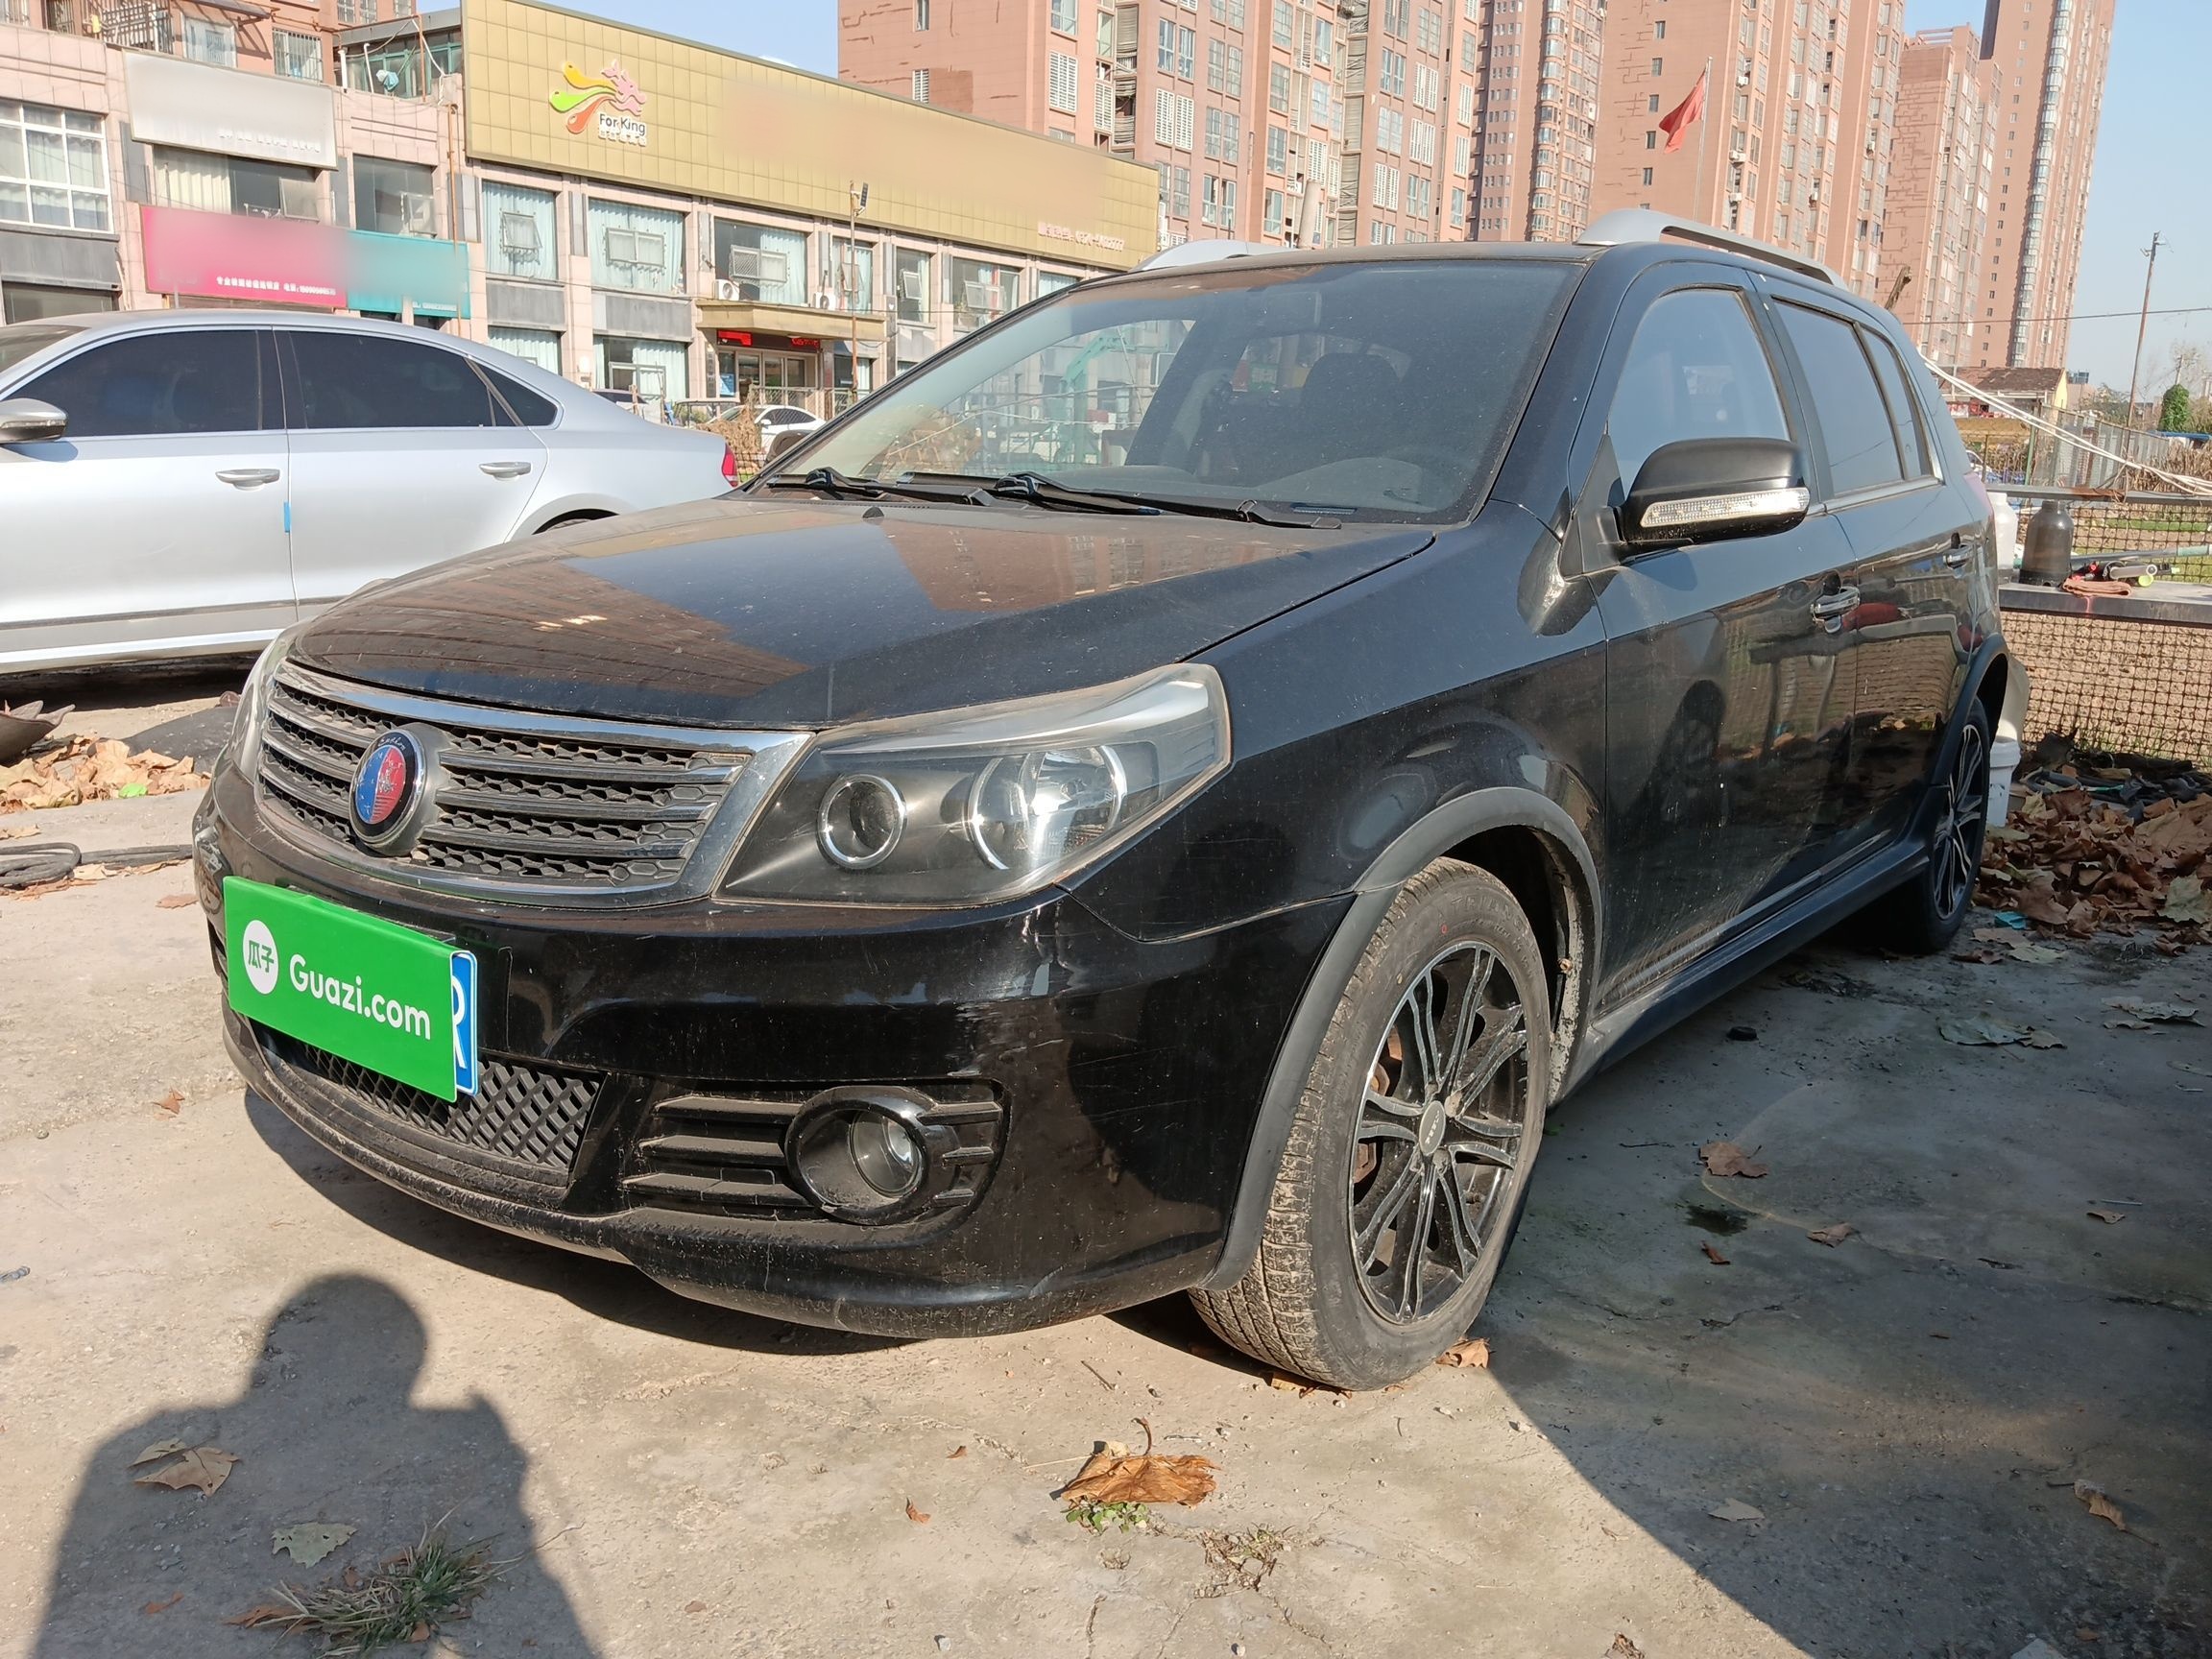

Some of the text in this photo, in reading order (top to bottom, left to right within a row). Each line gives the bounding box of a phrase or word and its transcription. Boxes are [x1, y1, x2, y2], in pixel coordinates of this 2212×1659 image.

[599, 113, 645, 136] For King
[248, 940, 275, 973] 瓜子
[289, 953, 431, 1040] Guazi.com
